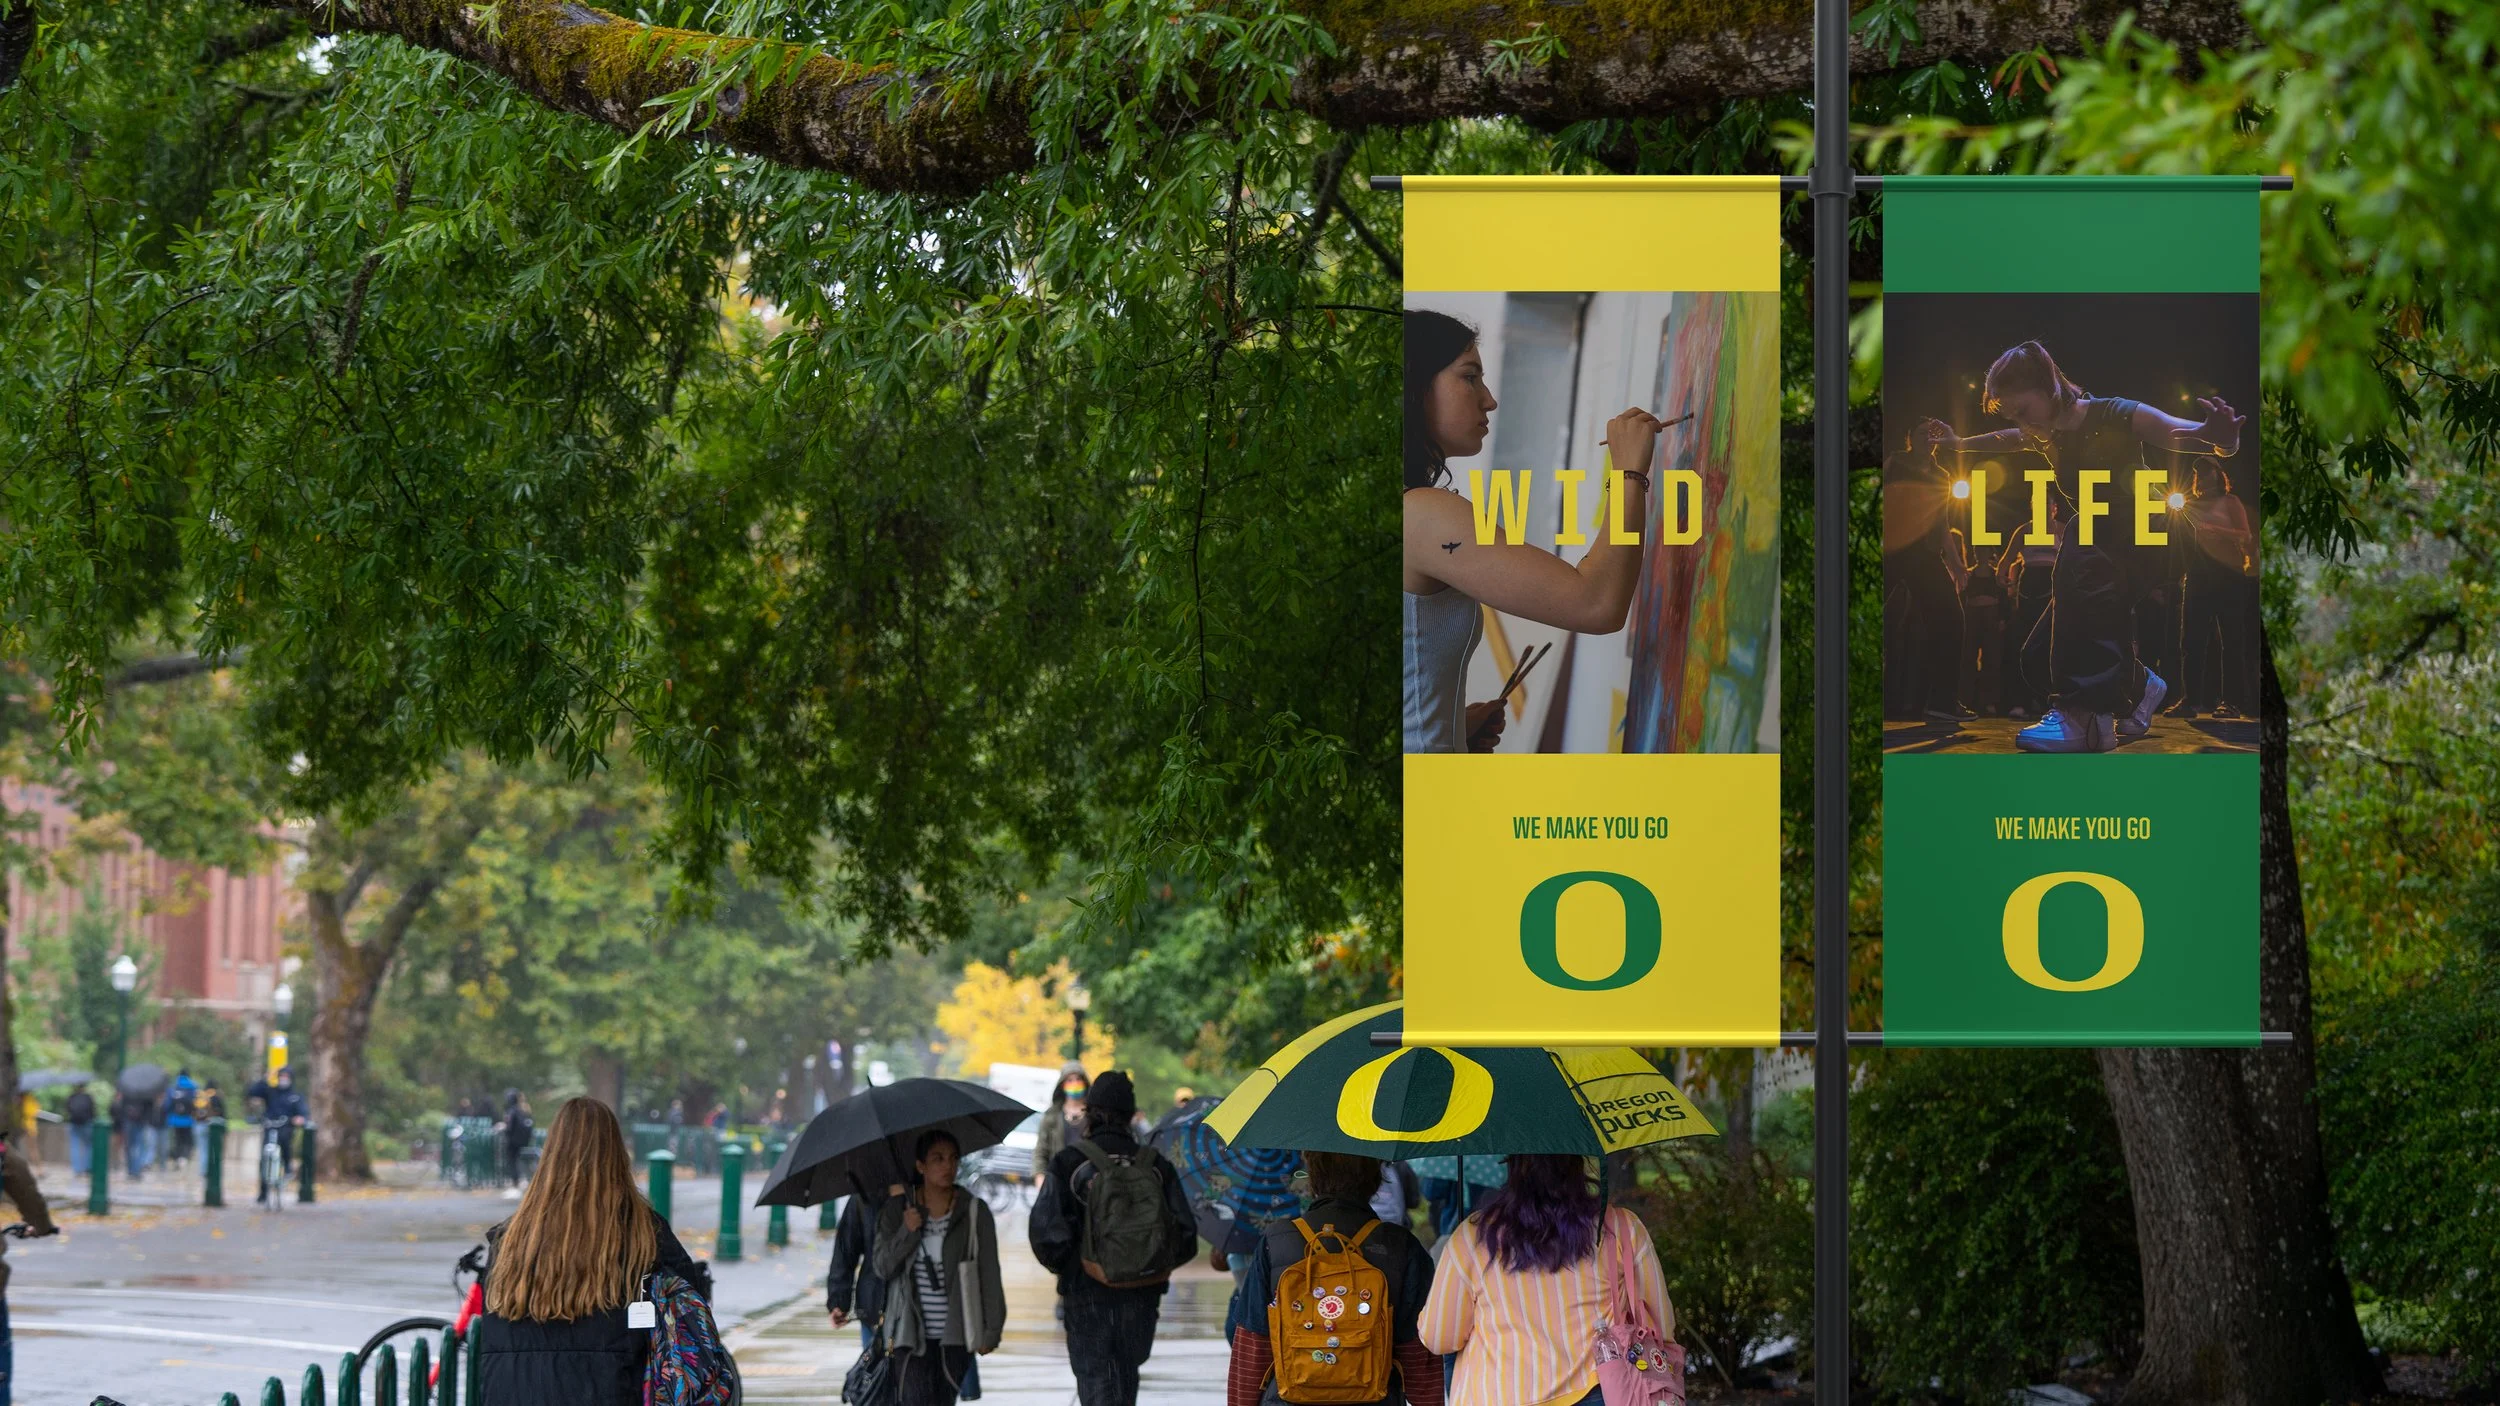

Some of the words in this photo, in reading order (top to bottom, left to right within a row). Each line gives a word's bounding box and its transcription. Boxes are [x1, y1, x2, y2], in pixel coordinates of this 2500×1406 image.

[1469, 469, 1704, 546] WILD
[1971, 469, 2169, 546] LIFE
[1512, 816, 1541, 840] WE
[1546, 816, 1599, 840] MAKE
[1603, 816, 1639, 840] YOU
[1644, 816, 1669, 840] GO
[1995, 817, 2024, 840] WE
[2028, 817, 2081, 840] MAKE
[2085, 817, 2121, 840] YOU
[2127, 817, 2151, 840] GO
[1519, 870, 1663, 992] O
[2001, 871, 2145, 992] O
[1336, 1046, 1494, 1143] O
[1600, 1105, 1688, 1134] DUCKS
